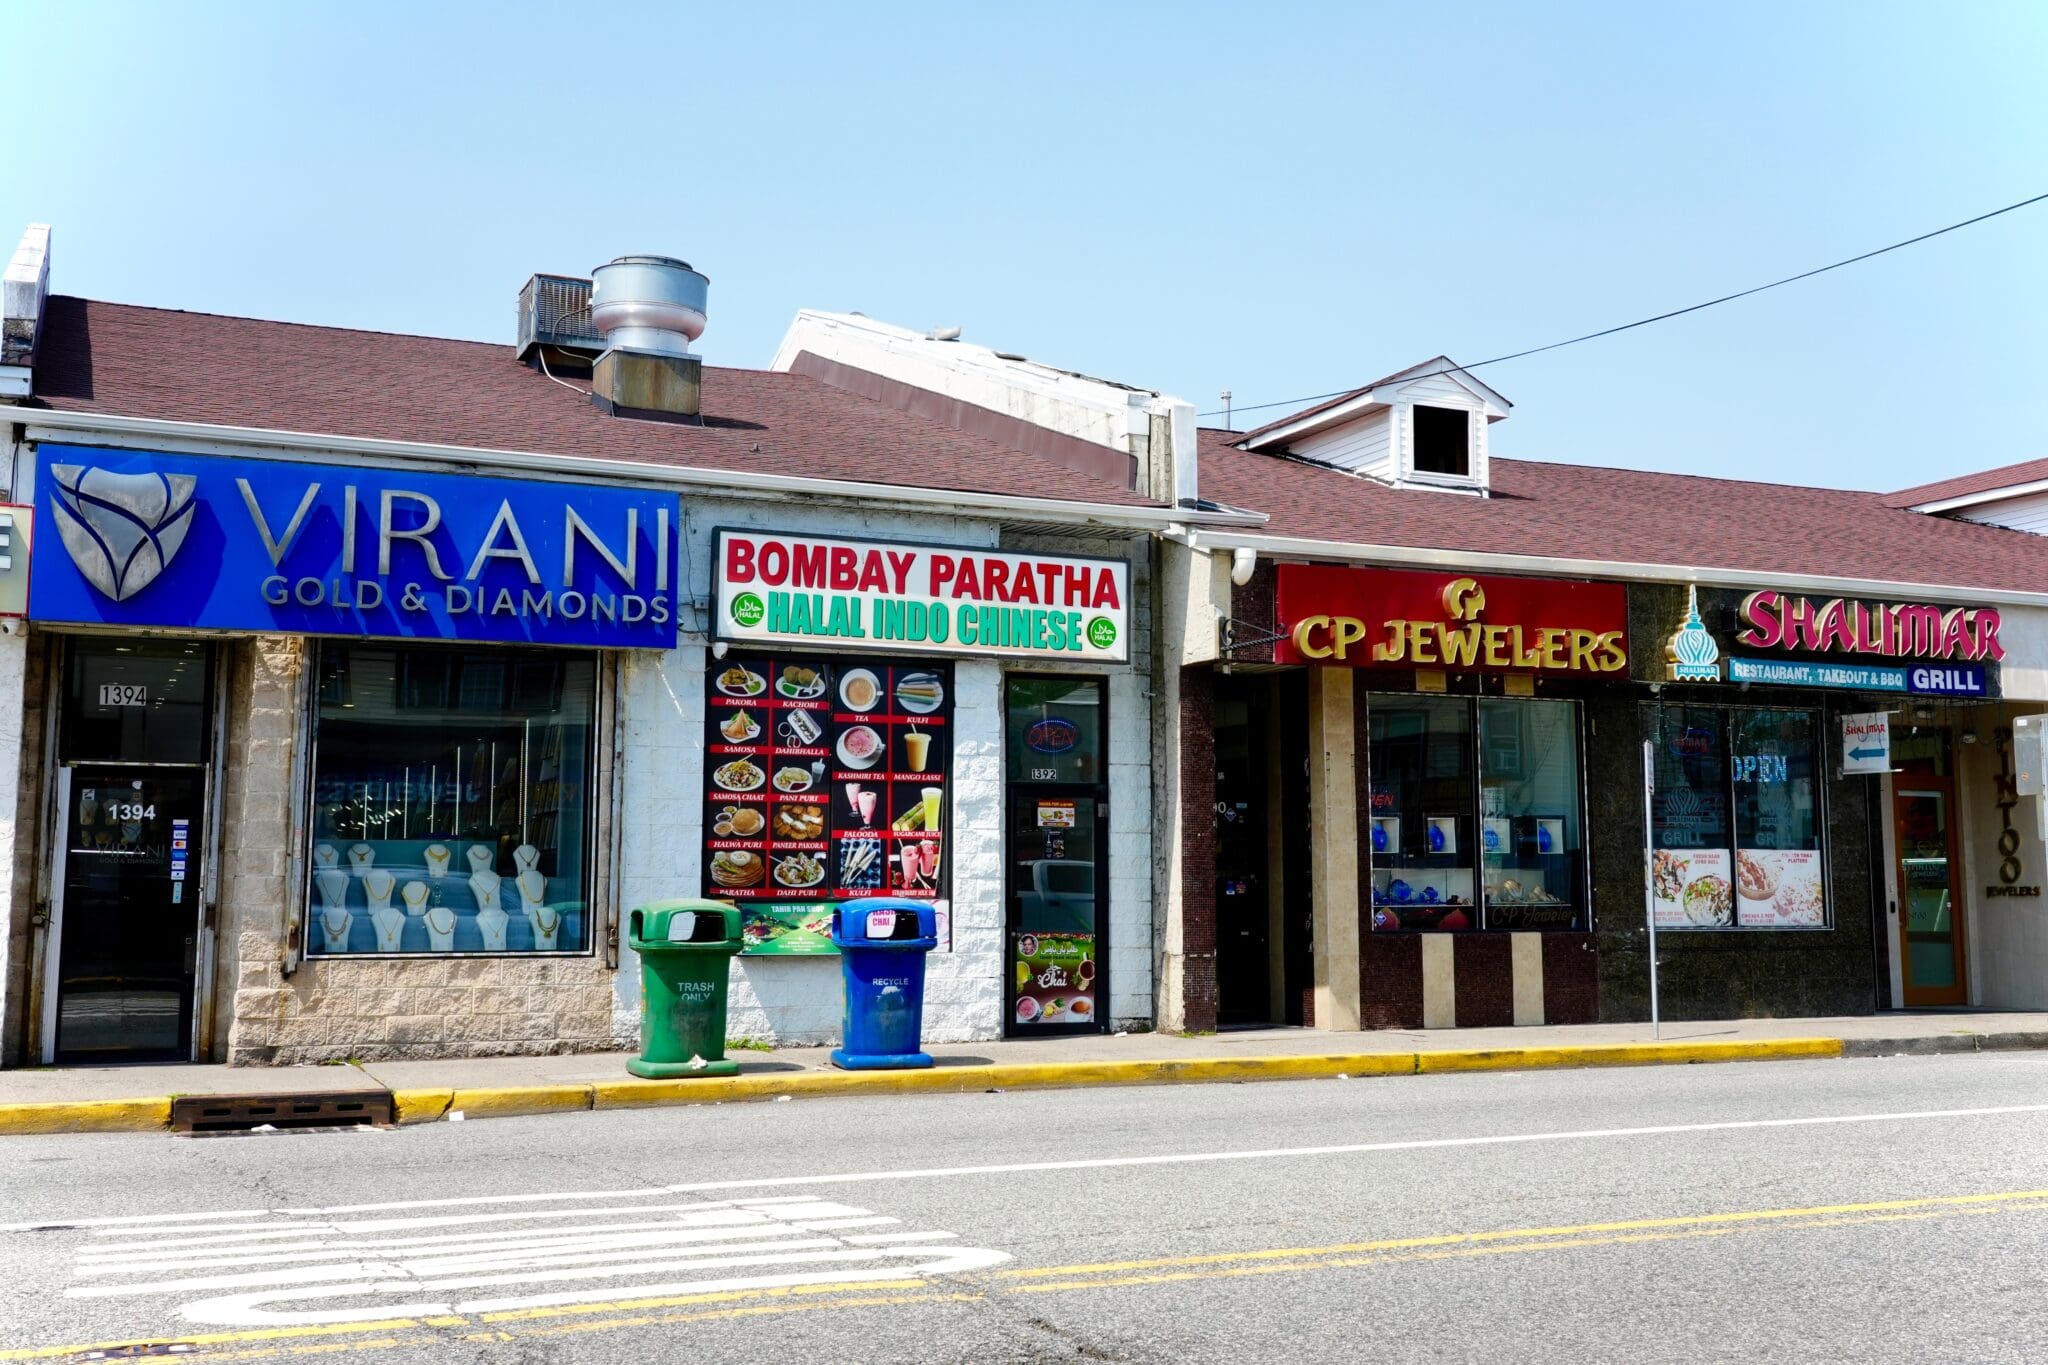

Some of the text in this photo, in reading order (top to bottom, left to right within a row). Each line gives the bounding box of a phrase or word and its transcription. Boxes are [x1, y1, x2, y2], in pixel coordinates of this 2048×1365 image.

[235, 478, 669, 591] VIRANI
[726, 538, 1121, 610] BOMBAY PARATHA
[261, 575, 669, 624] GOLD & DIAMONDS
[738, 609, 762, 620] HALAL
[766, 591, 1083, 652] HALAL INDO CHINESE
[1094, 633, 1115, 643] HALAL
[1292, 615, 1628, 672] CP JEWELERS
[1733, 660, 1980, 692] RESTAURANT, TAKEOUT & BBQ GRILL
[102, 686, 146, 705] 1394
[725, 698, 757, 707] PAKORA
[782, 701, 819, 709] KACHORI
[906, 716, 929, 724] KULFI
[1027, 728, 1077, 746] OPEN
[838, 772, 885, 781] KASHMIRI TEA
[894, 773, 941, 782] MANGO LASSI
[1033, 769, 1056, 779] 1392
[108, 804, 156, 820] 1394
[1662, 831, 1705, 846] GRILL
[776, 889, 817, 897] DAHI PURI
[849, 889, 872, 897] KULFI
[873, 917, 890, 927] CHAI
[872, 977, 909, 986] RECYCLE
[1037, 971, 1068, 989] Chai
[677, 982, 715, 992] TRASH
[681, 992, 711, 1002] ONLY
